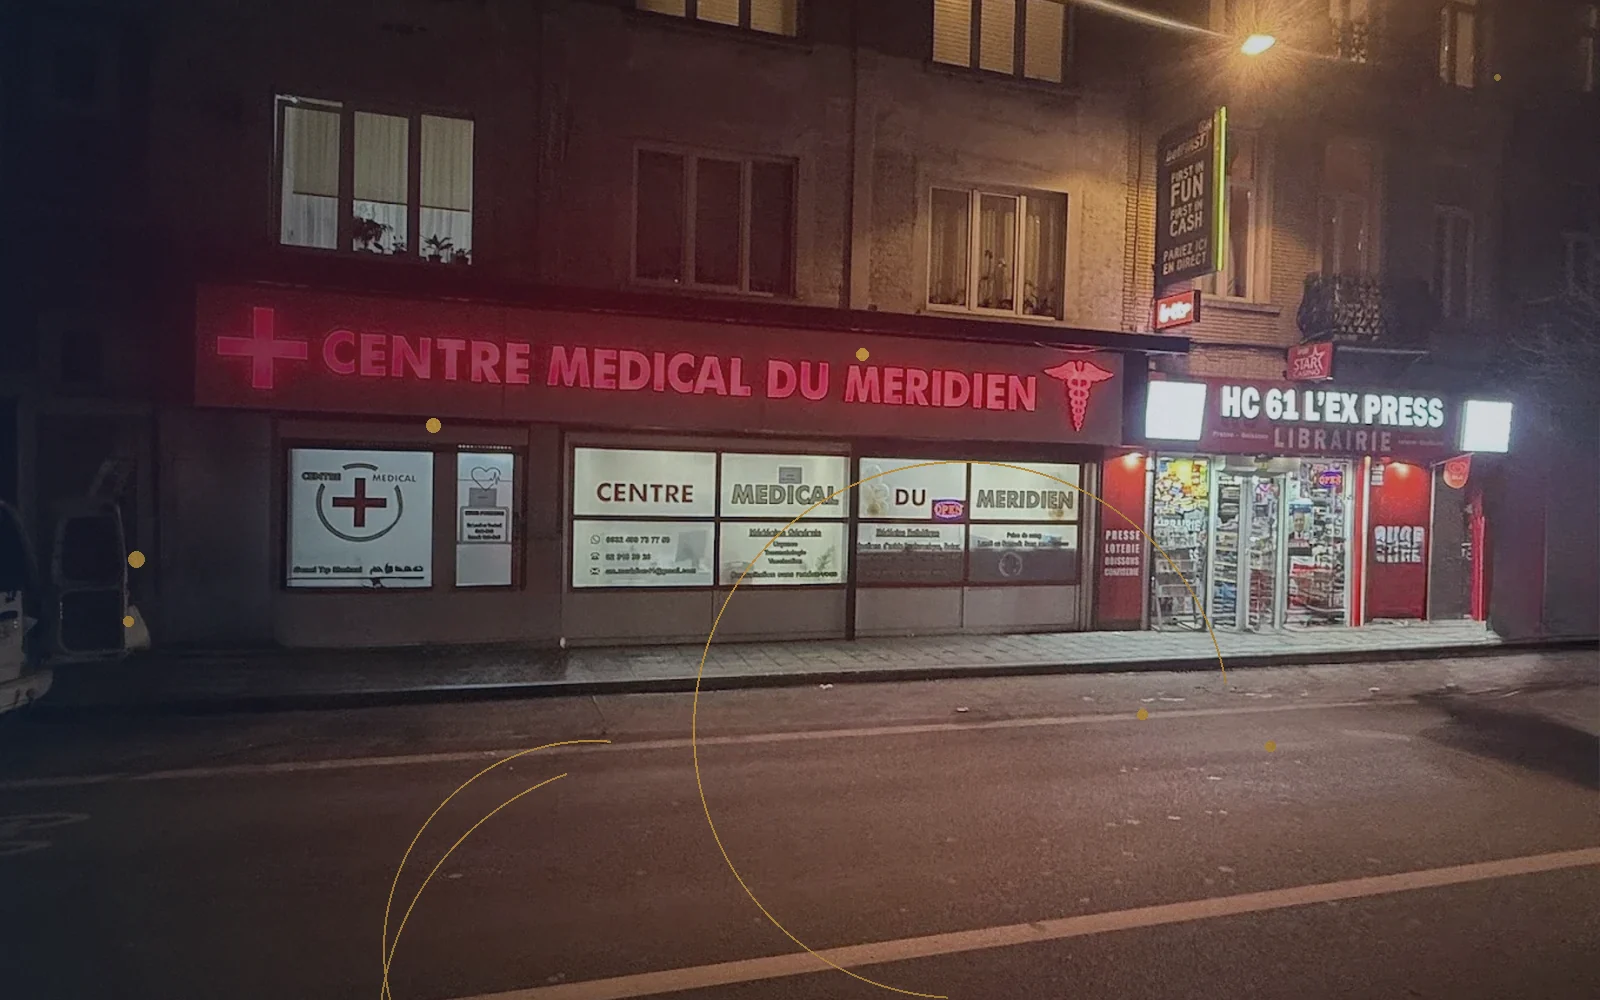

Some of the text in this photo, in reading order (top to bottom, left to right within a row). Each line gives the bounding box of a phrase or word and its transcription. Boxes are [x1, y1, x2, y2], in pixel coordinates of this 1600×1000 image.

[1171, 164, 1194, 183] FIRST
[1170, 171, 1204, 207] FUN
[1169, 203, 1193, 220] FIRST
[1169, 211, 1203, 237] CASH
[1162, 251, 1207, 275] EN DIRECT
[1163, 242, 1193, 262] PARIEZ
[322, 329, 1037, 412] CENTRE MEDICAL DU MERIDIEN
[1221, 385, 1444, 428] HC 61 L'EX PRESS
[1273, 426, 1392, 452] LIBRAIRIE
[372, 474, 417, 483] MEDICAL
[596, 483, 1073, 510] CENTRE MEDICAL DU MERIDIEN
[1105, 529, 1141, 541] PRESSE
